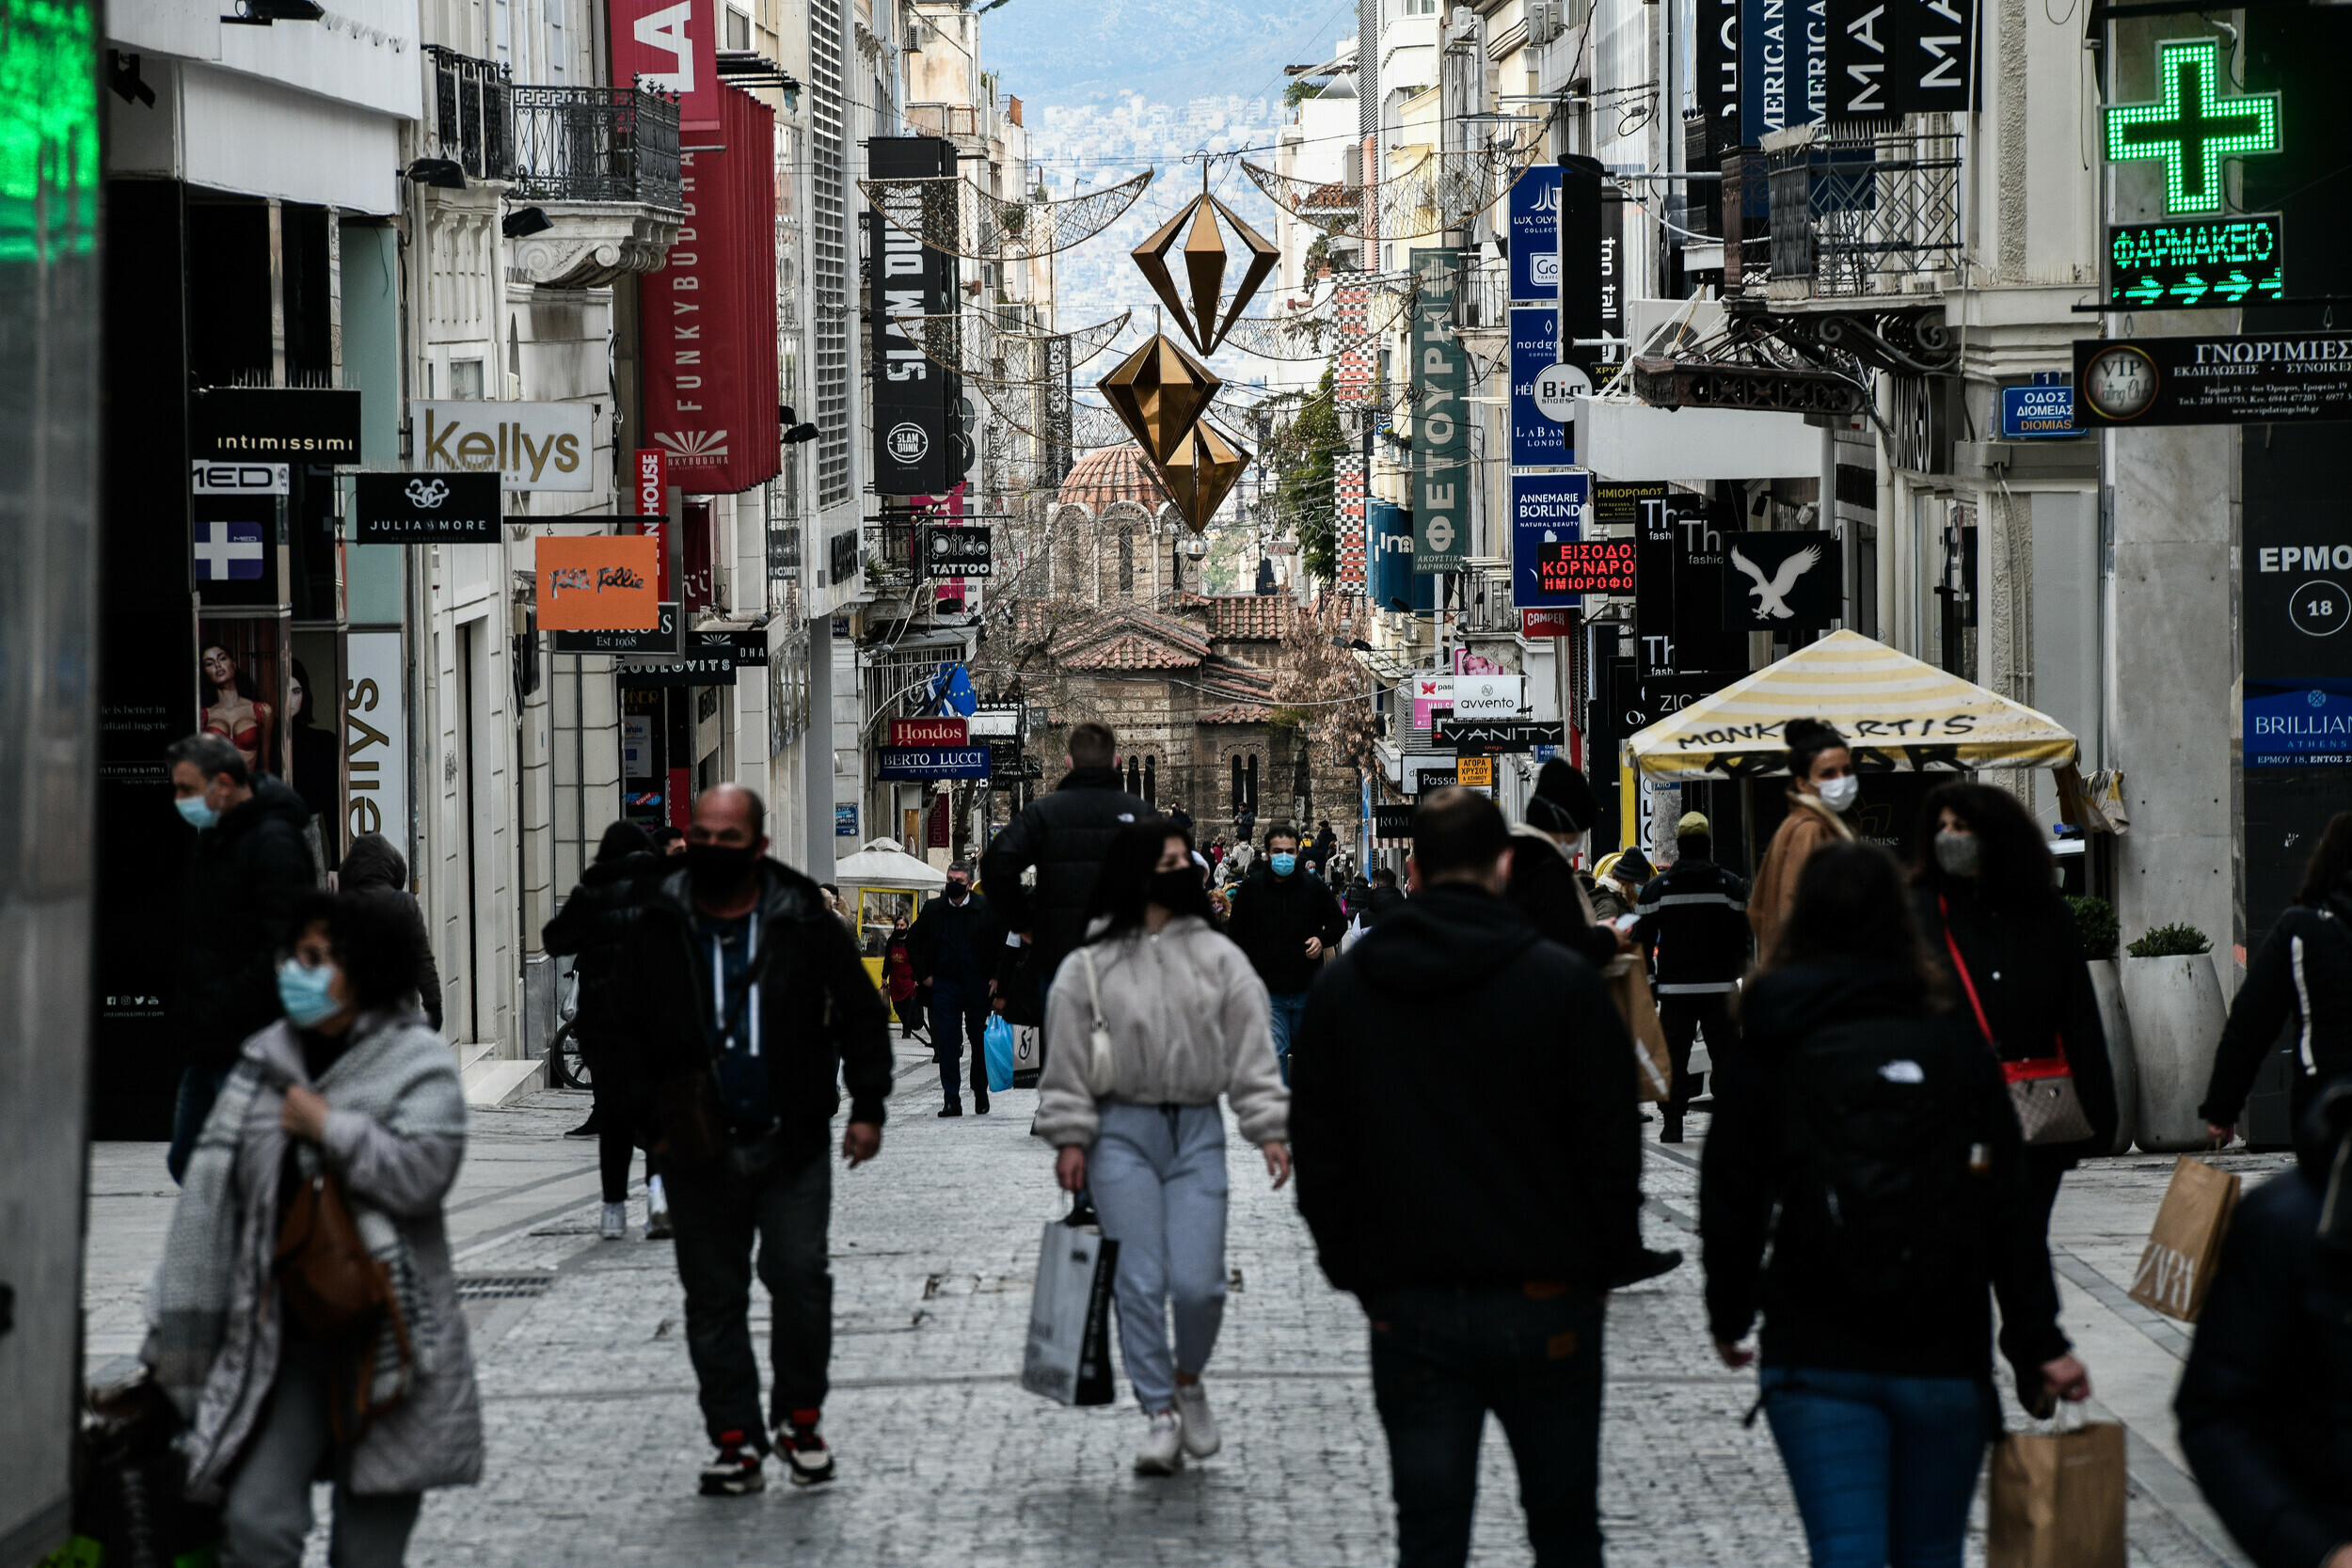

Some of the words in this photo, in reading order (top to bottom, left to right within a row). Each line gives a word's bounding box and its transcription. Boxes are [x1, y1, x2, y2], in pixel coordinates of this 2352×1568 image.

[1514, 216, 1534, 226] LUX
[2195, 340, 2352, 364] ΓΝΩΡΙΜΙΕΣ
[2101, 356, 2142, 377] VIP
[2173, 364, 2260, 377] ΕΚΔΗΛΩΣΕΙΣ
[2042, 372, 2049, 385] 1
[2024, 392, 2067, 404] ΟΔΟΣ
[2016, 404, 2074, 417] ΔΙΟΜΕΙΑΣ
[2021, 420, 2072, 430] DIOMIAS
[217, 435, 354, 451] intimissimi
[897, 434, 919, 443] SLAM
[897, 443, 919, 452] DUNK
[1519, 493, 1579, 503] ANNEMARIE
[1519, 505, 1581, 517] BÖRLIND
[370, 520, 422, 531] JULIA
[439, 520, 486, 531] MORE
[931, 531, 989, 560] Dildo
[1561, 545, 1636, 560] ΕΙΣΟΔΟ
[930, 564, 990, 575] TATTOO
[1543, 560, 1635, 576] ΚΟΡΝΑΡΟ
[1545, 577, 1632, 590] ΗΜΙΟΡΟΦΟ
[2307, 600, 2333, 616] 18
[1527, 612, 1565, 626] CAMPER
[596, 636, 612, 646] Est
[615, 636, 637, 647] 1968
[1460, 697, 1515, 709] avvento
[898, 723, 961, 740] Hondos
[2256, 716, 2352, 735] BRILLIA
[1445, 727, 1561, 741] VANITY
[2287, 740, 2347, 749] ATHENS
[884, 753, 930, 766] BERTO
[940, 752, 981, 765] LUCCI
